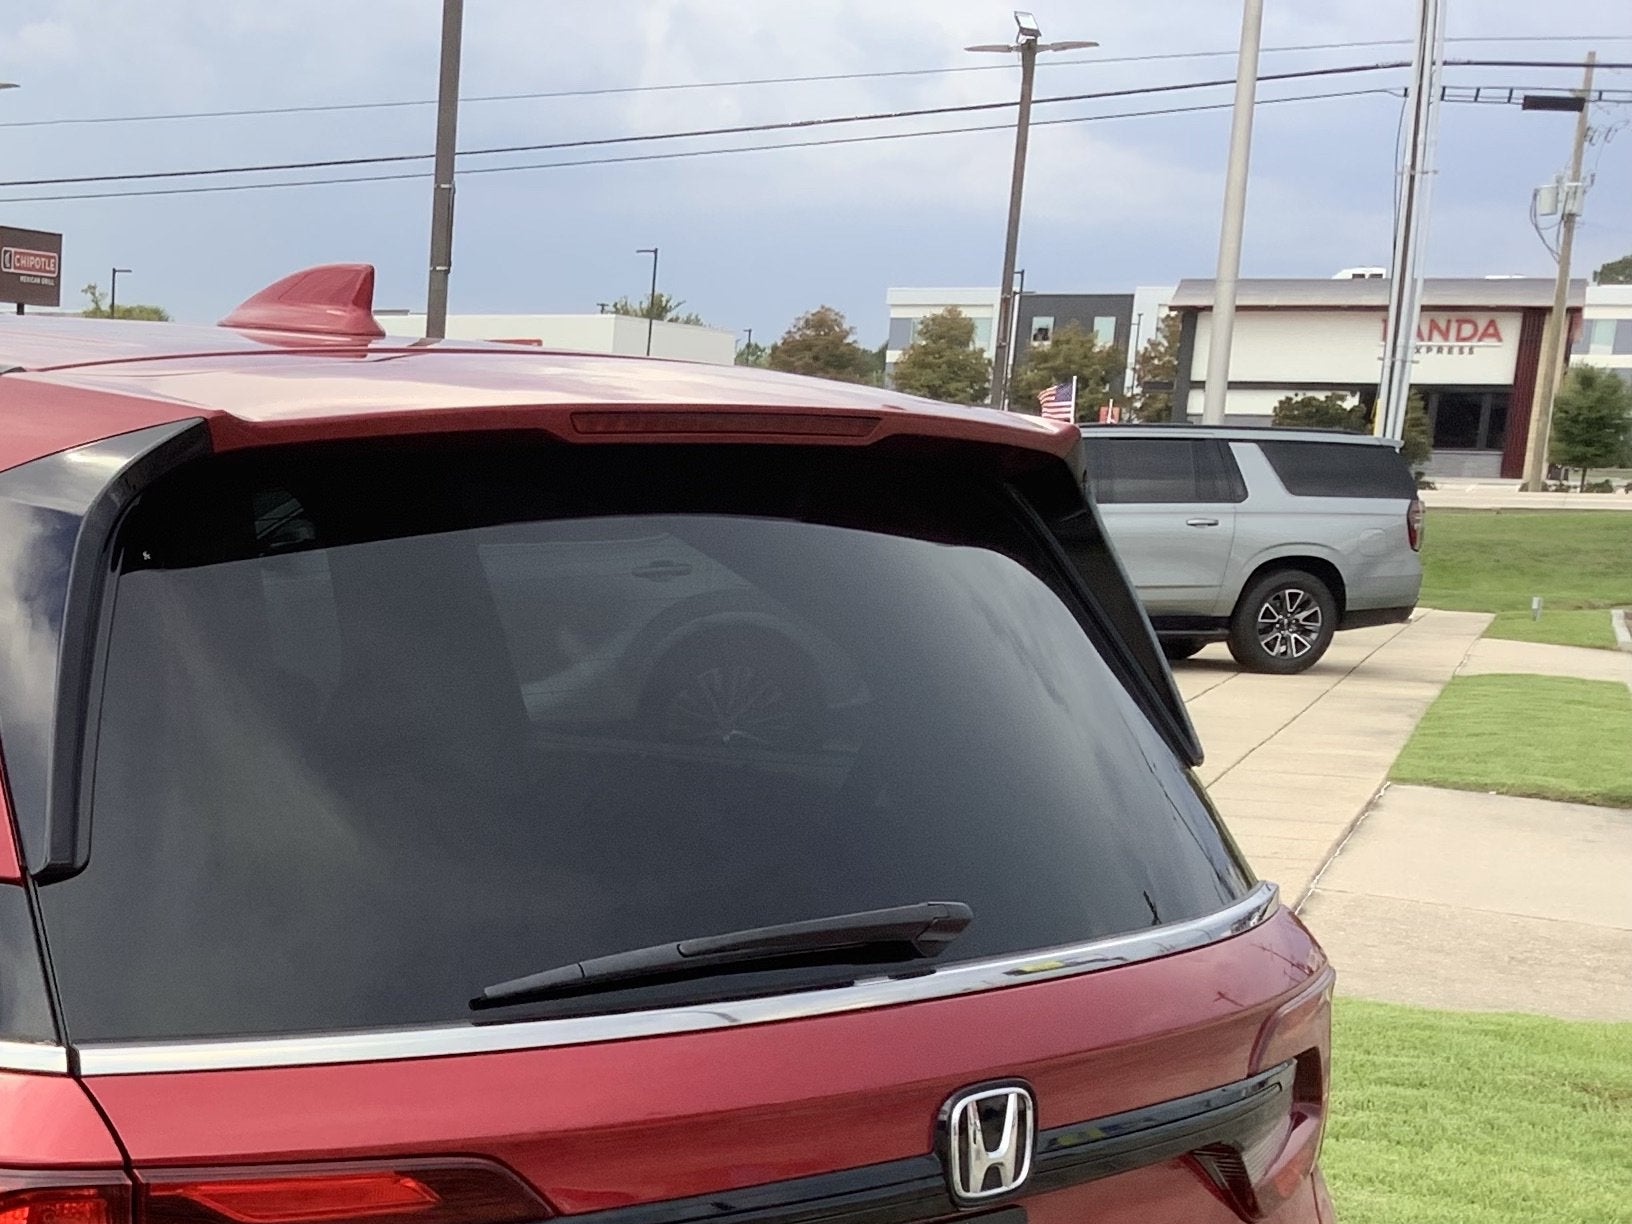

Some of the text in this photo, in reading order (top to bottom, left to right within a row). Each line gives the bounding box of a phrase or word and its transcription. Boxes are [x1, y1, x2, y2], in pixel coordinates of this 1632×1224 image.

[14, 254, 55, 272] CHIPOTLE
[1381, 318, 1503, 343] NDA
[1413, 345, 1475, 355] XPRESS
